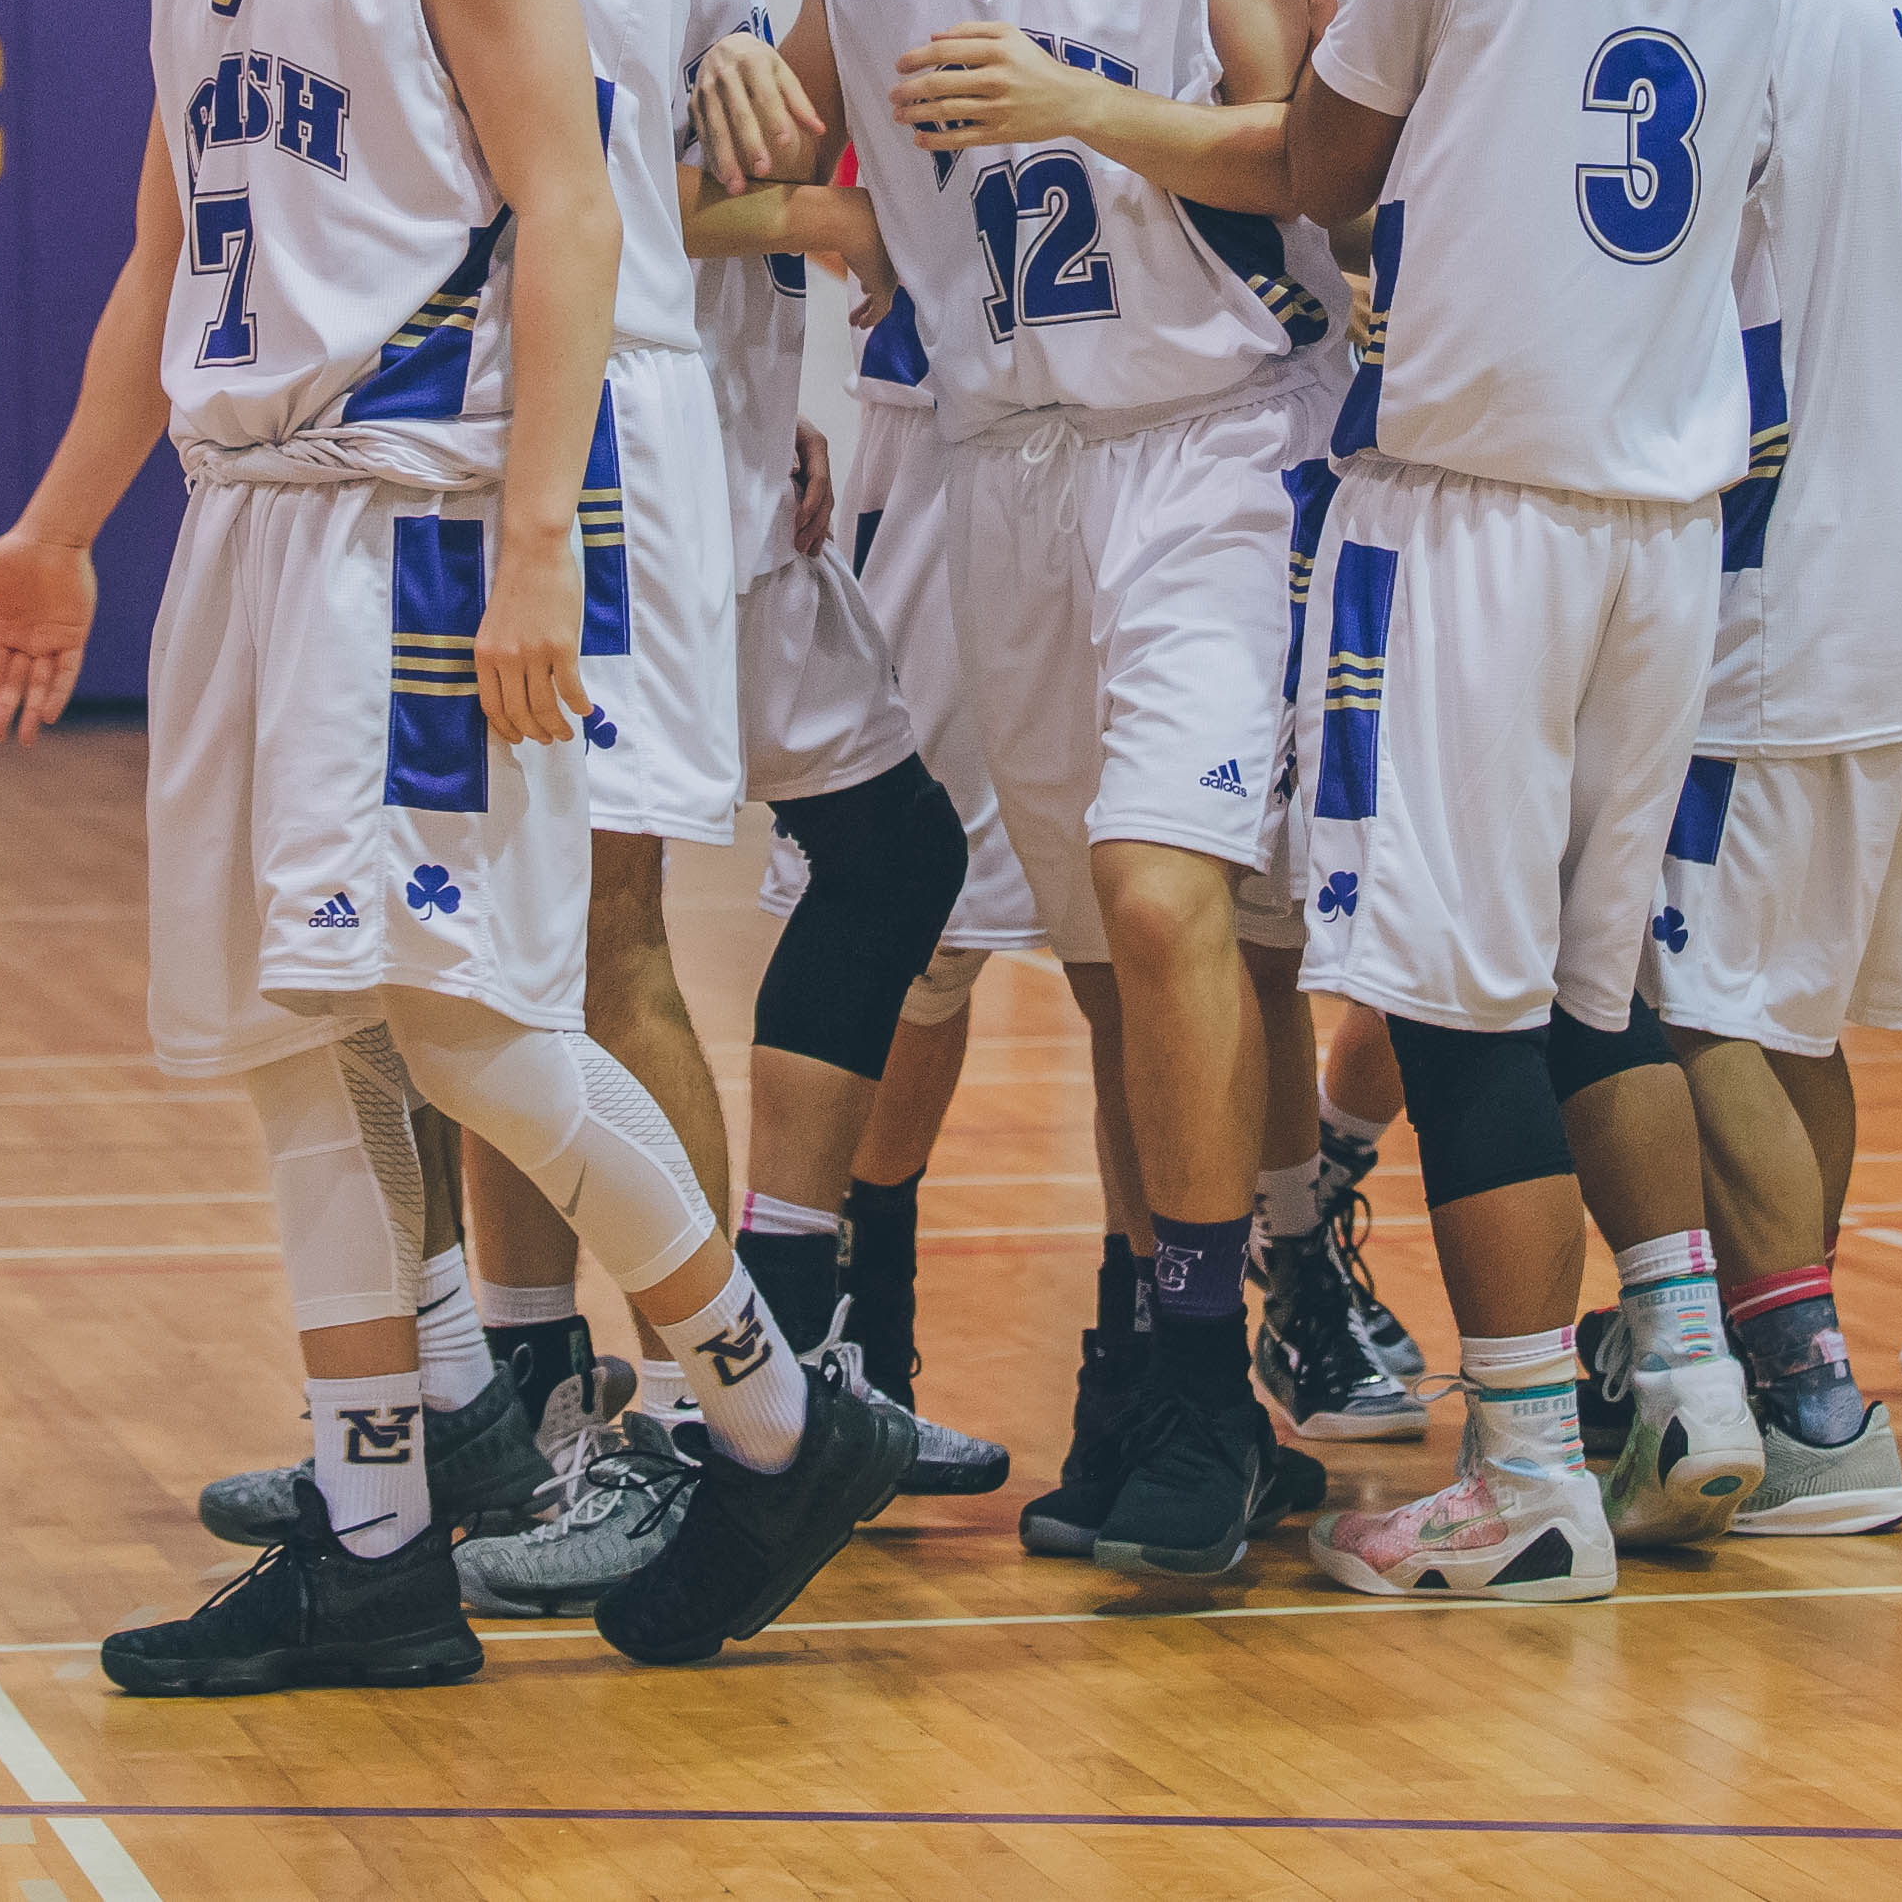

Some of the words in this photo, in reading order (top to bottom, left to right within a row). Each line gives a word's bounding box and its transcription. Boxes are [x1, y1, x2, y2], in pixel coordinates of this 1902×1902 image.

[1575, 27, 1706, 264] 3
[190, 184, 258, 369] 7
[971, 149, 1121, 344] 12
[1199, 777, 1247, 798] adidas
[308, 914, 360, 928] adidas
